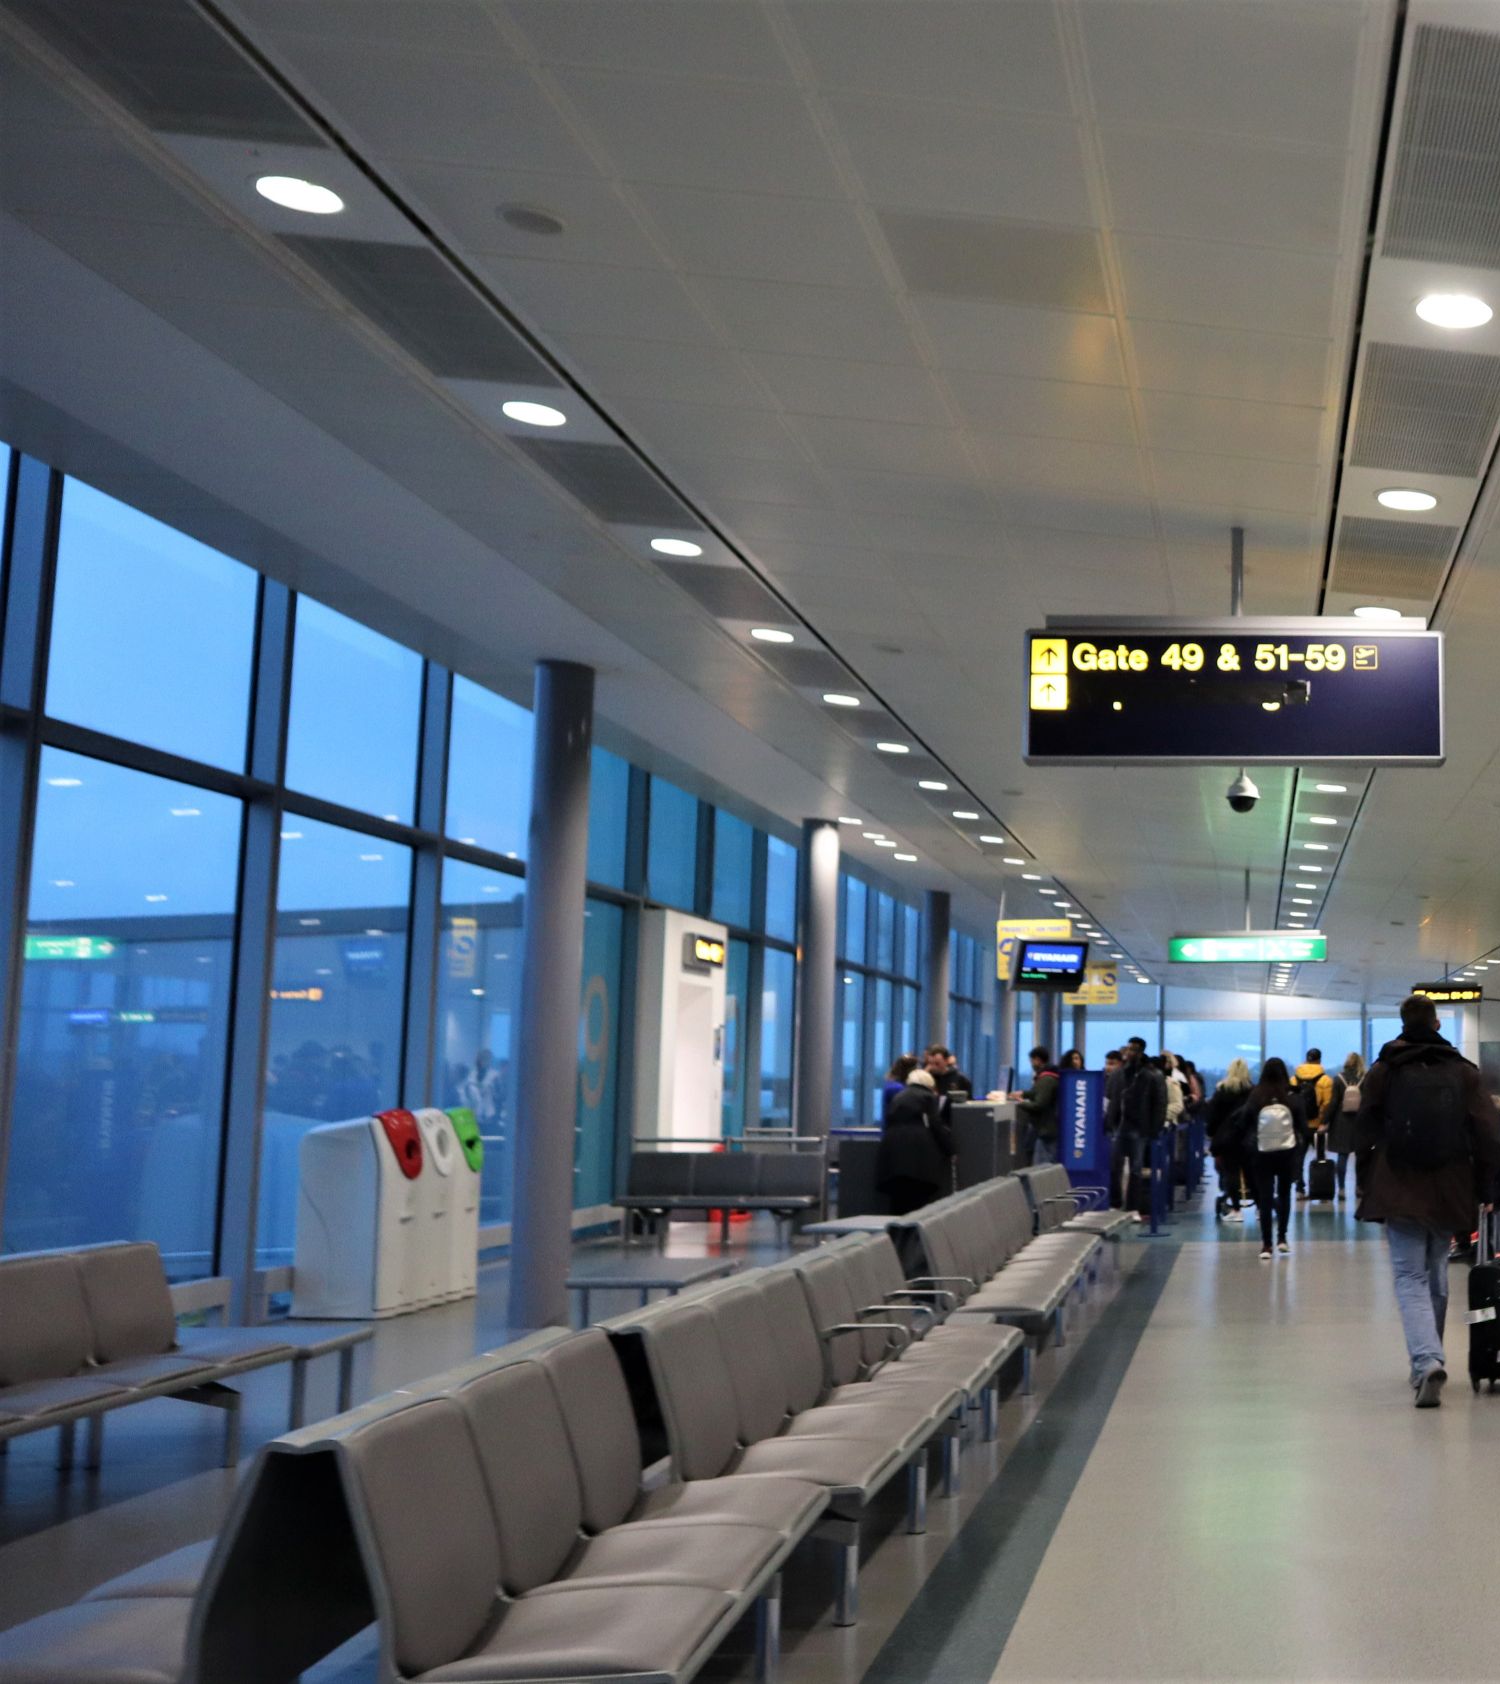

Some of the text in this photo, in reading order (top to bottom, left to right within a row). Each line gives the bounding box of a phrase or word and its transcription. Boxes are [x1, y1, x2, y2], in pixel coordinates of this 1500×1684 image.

[1072, 643, 1346, 671] Gate 49 & 51-59
[1033, 952, 1079, 963] RYANAIR
[1074, 1080, 1087, 1148] RYANAIR
